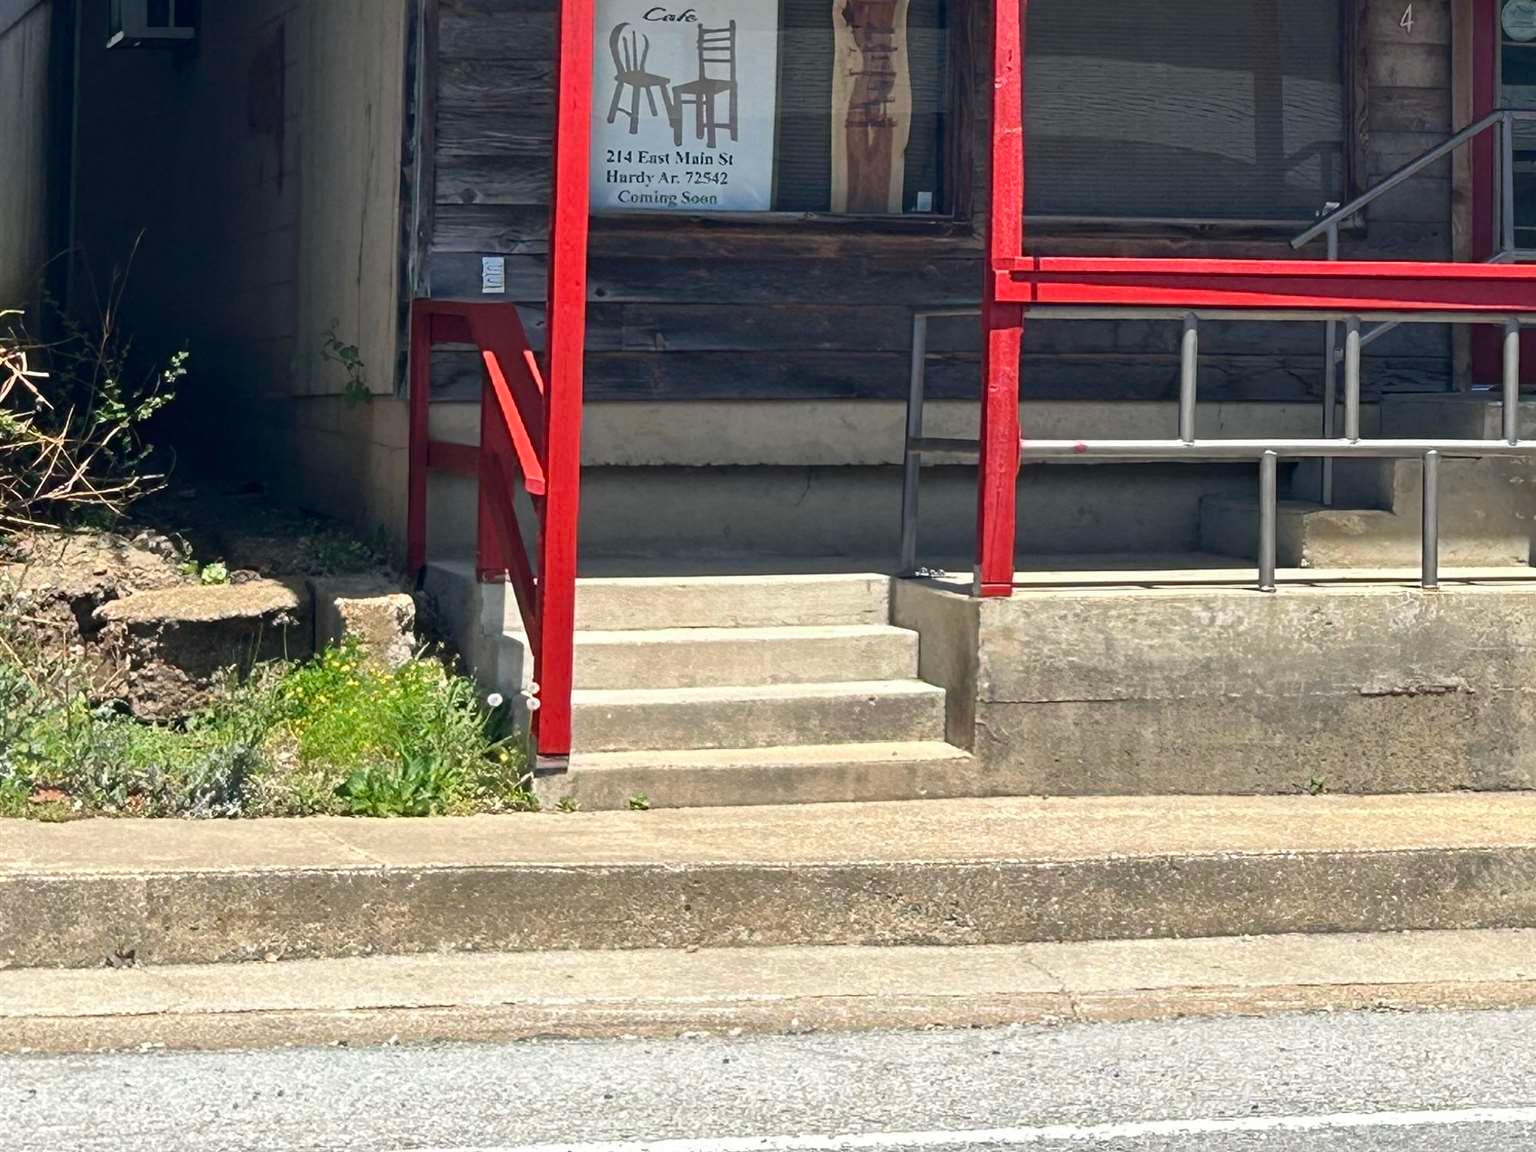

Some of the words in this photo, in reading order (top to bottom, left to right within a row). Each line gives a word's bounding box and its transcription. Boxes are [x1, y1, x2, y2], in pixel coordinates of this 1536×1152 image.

[642, 6, 698, 23] Cafe
[606, 149, 632, 164] 214
[638, 150, 670, 165] East
[675, 151, 714, 166] Main
[718, 152, 733, 167] St
[606, 169, 654, 188] Hardy
[658, 171, 680, 185] Ar.
[685, 171, 729, 185] 72542
[617, 190, 677, 208] Coming
[680, 191, 718, 205] Soon
